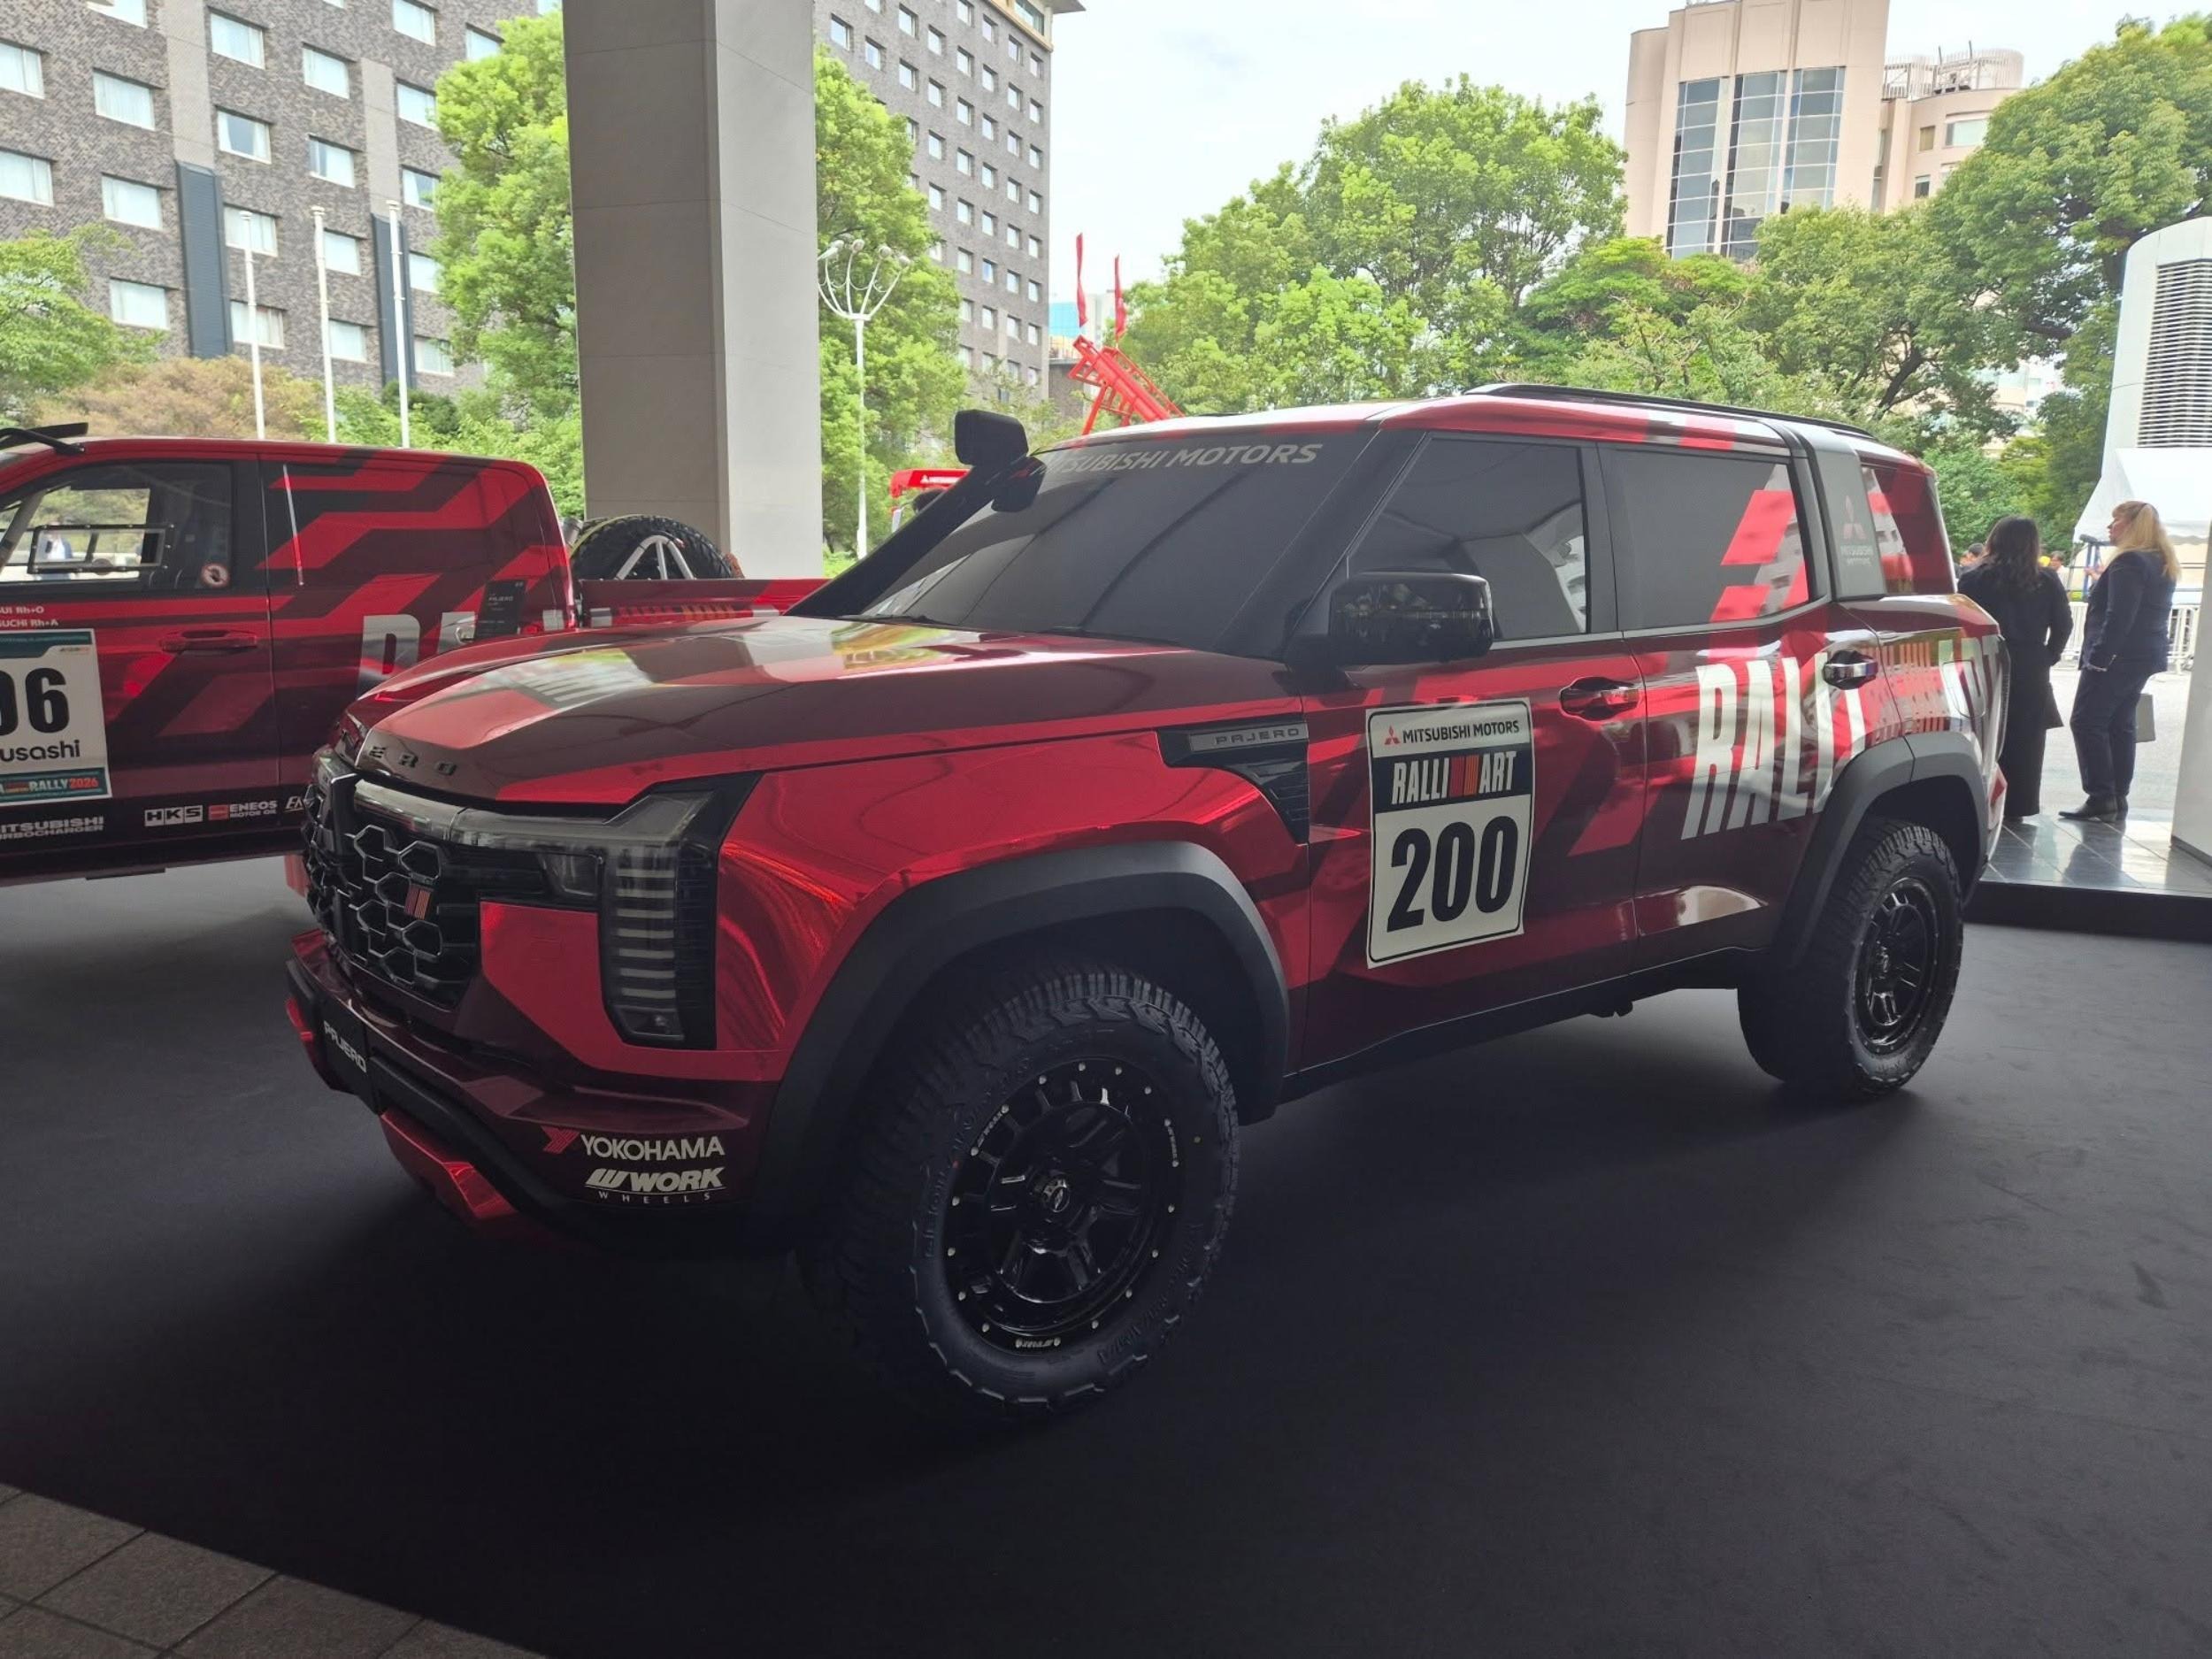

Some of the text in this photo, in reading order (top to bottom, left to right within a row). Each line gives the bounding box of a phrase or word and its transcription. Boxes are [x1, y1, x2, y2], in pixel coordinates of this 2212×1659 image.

[1166, 443, 1323, 466] MOTORS
[1216, 728, 1300, 745] PAJERO
[1402, 720, 1520, 743] MITSUBISHI MOTORS
[28, 779, 68, 792] RALLY
[69, 777, 99, 789] 2026
[1391, 751, 1517, 804] RALLI ART
[146, 806, 202, 823] HKS
[230, 801, 278, 812] ENEOS
[1386, 816, 1519, 933] 200
[324, 1020, 367, 1072] PAJERO
[580, 1136, 726, 1161] YOKOHAMA
[631, 1166, 726, 1192] WORK
[598, 1191, 710, 1204] WHEELS
